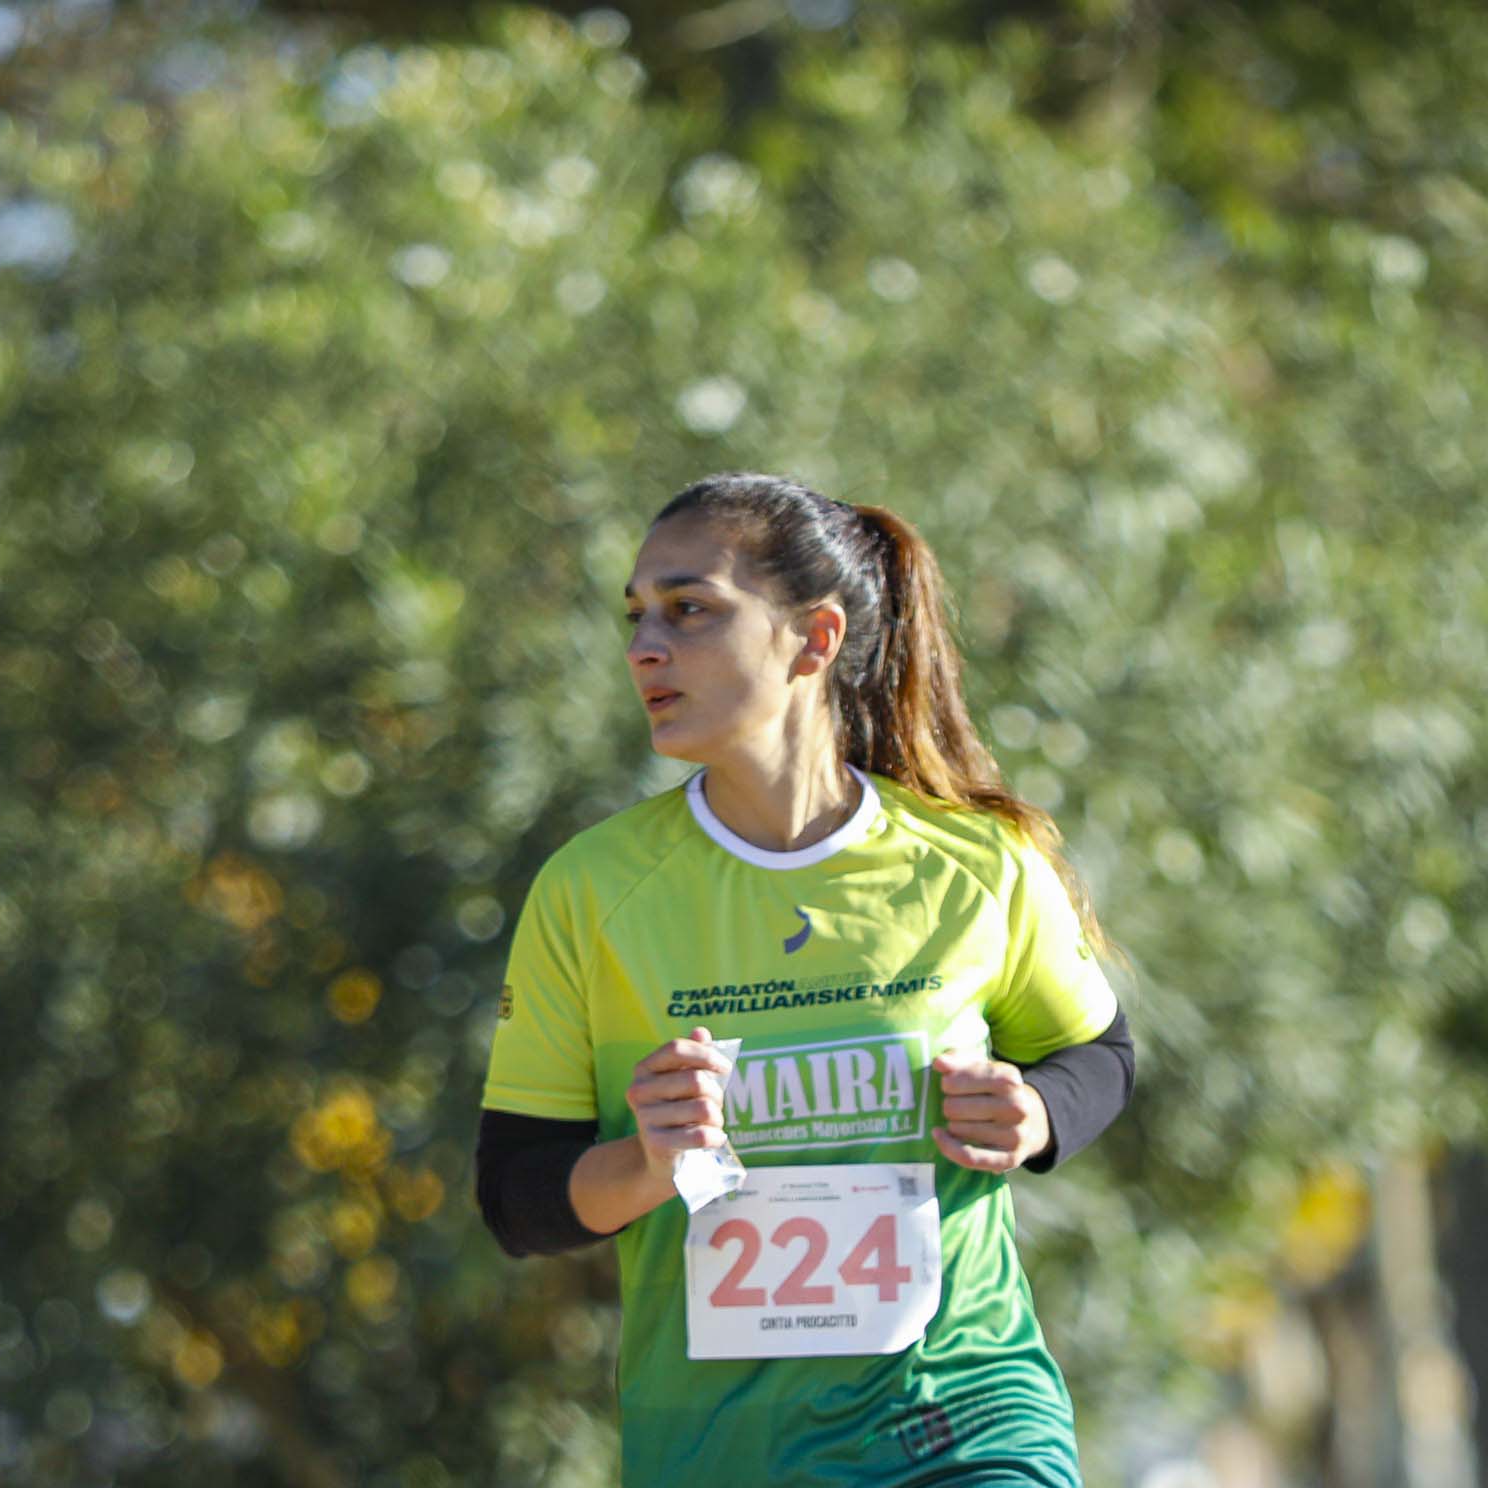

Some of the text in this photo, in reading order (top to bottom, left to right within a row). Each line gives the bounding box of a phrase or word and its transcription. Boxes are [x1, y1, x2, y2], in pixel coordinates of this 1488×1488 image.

[667, 975, 944, 1018] CAWILLIAMSKEMMIS
[725, 1044, 915, 1127] MAIRA
[708, 1213, 912, 1308] 224
